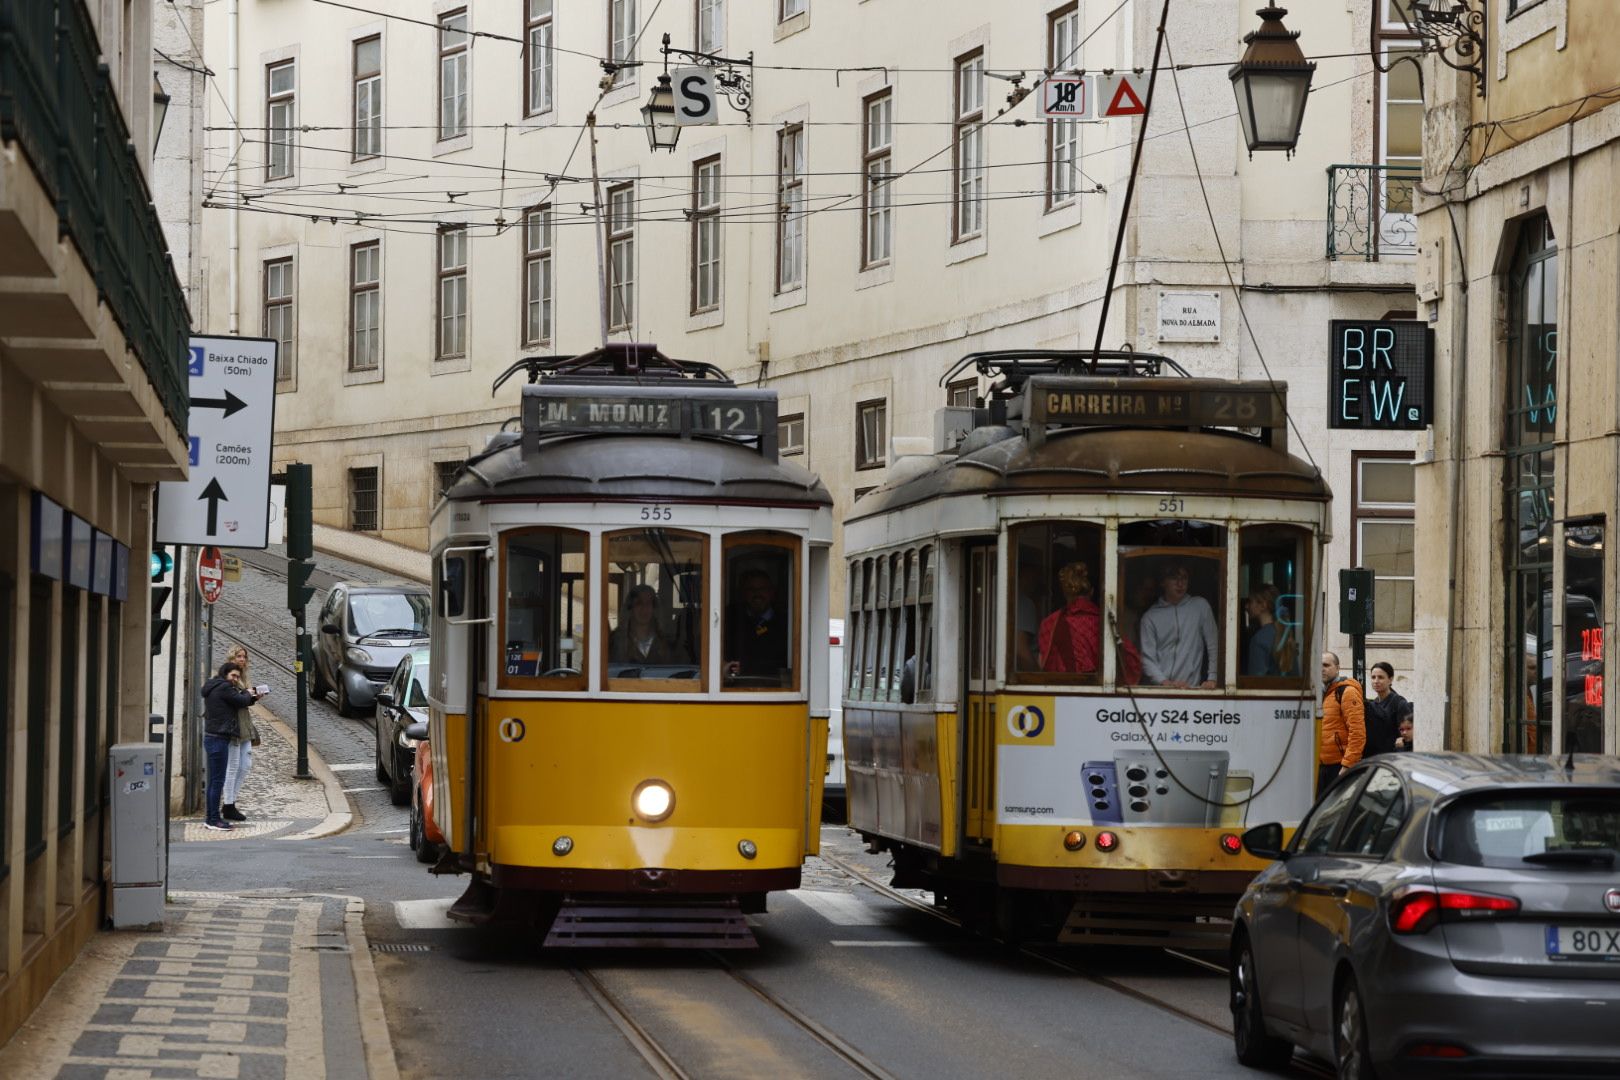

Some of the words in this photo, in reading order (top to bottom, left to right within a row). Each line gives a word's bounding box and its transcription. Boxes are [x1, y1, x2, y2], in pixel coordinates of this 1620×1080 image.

[681, 76, 710, 117] S
[1054, 83, 1075, 102] 10
[1188, 319, 1216, 327] ALMADA
[1343, 328, 1393, 369] BR
[208, 353, 234, 363] Baixa
[237, 355, 268, 365] Chiado
[224, 366, 252, 376] (50m)
[1047, 393, 1145, 414] CARREIRA
[1215, 396, 1257, 419] 28
[549, 403, 576, 421] M.
[590, 404, 668, 423] MONIZ
[711, 407, 745, 430] 12
[215, 443, 252, 453] Camões
[215, 455, 250, 465] (200m)
[1159, 499, 1184, 512] 551
[641, 507, 672, 520] 555
[507, 665, 519, 674] 01
[1096, 709, 1158, 727] Galaxy
[1161, 710, 1189, 724] S24
[1193, 709, 1241, 724] Series
[1156, 732, 1167, 742] AI
[1183, 732, 1228, 746] chegou
[1005, 806, 1054, 816] samsung.com
